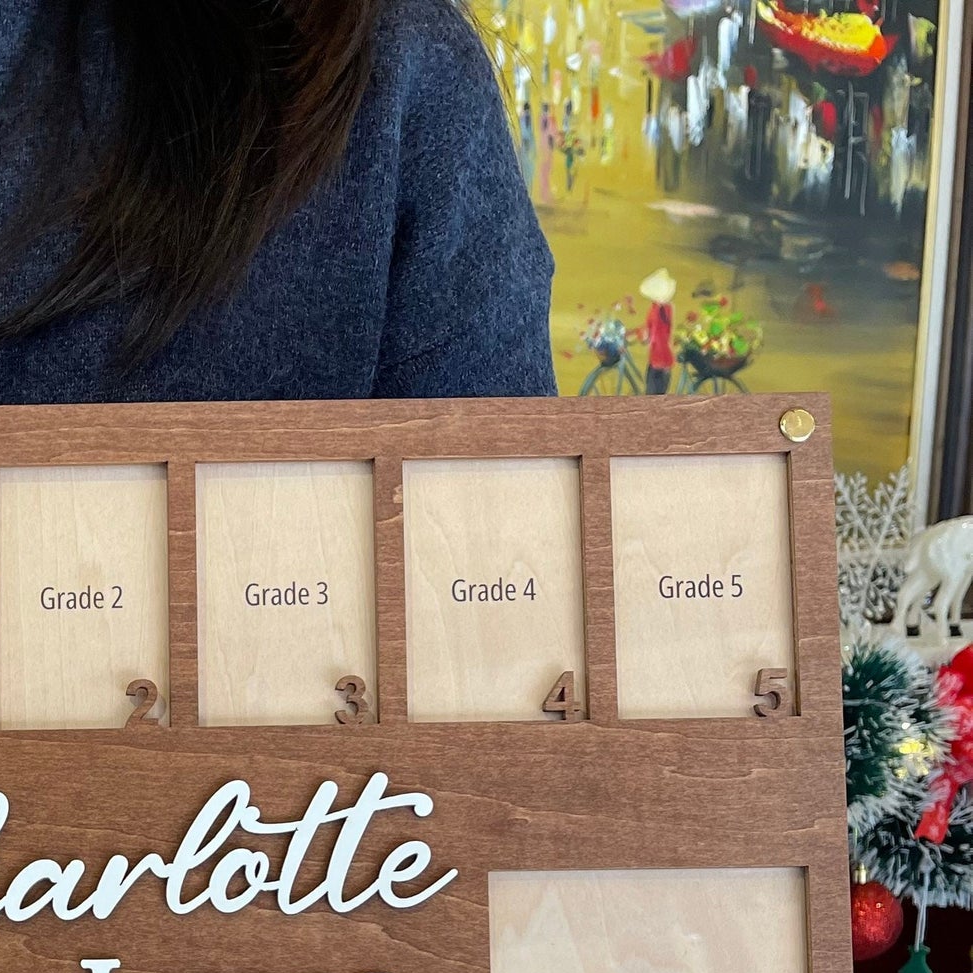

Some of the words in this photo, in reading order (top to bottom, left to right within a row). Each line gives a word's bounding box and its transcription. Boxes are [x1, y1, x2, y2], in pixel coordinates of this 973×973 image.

[41, 585, 104, 609] Grade
[112, 586, 122, 608] 2
[246, 582, 309, 606] Grade
[317, 582, 328, 604] 3
[452, 577, 516, 602] Grade
[523, 578, 536, 600] 4
[659, 574, 723, 598] Grade
[732, 575, 742, 597] 5
[125, 679, 159, 728] 2
[334, 675, 369, 724] 3
[542, 671, 581, 720] 4
[754, 668, 788, 717] 5
